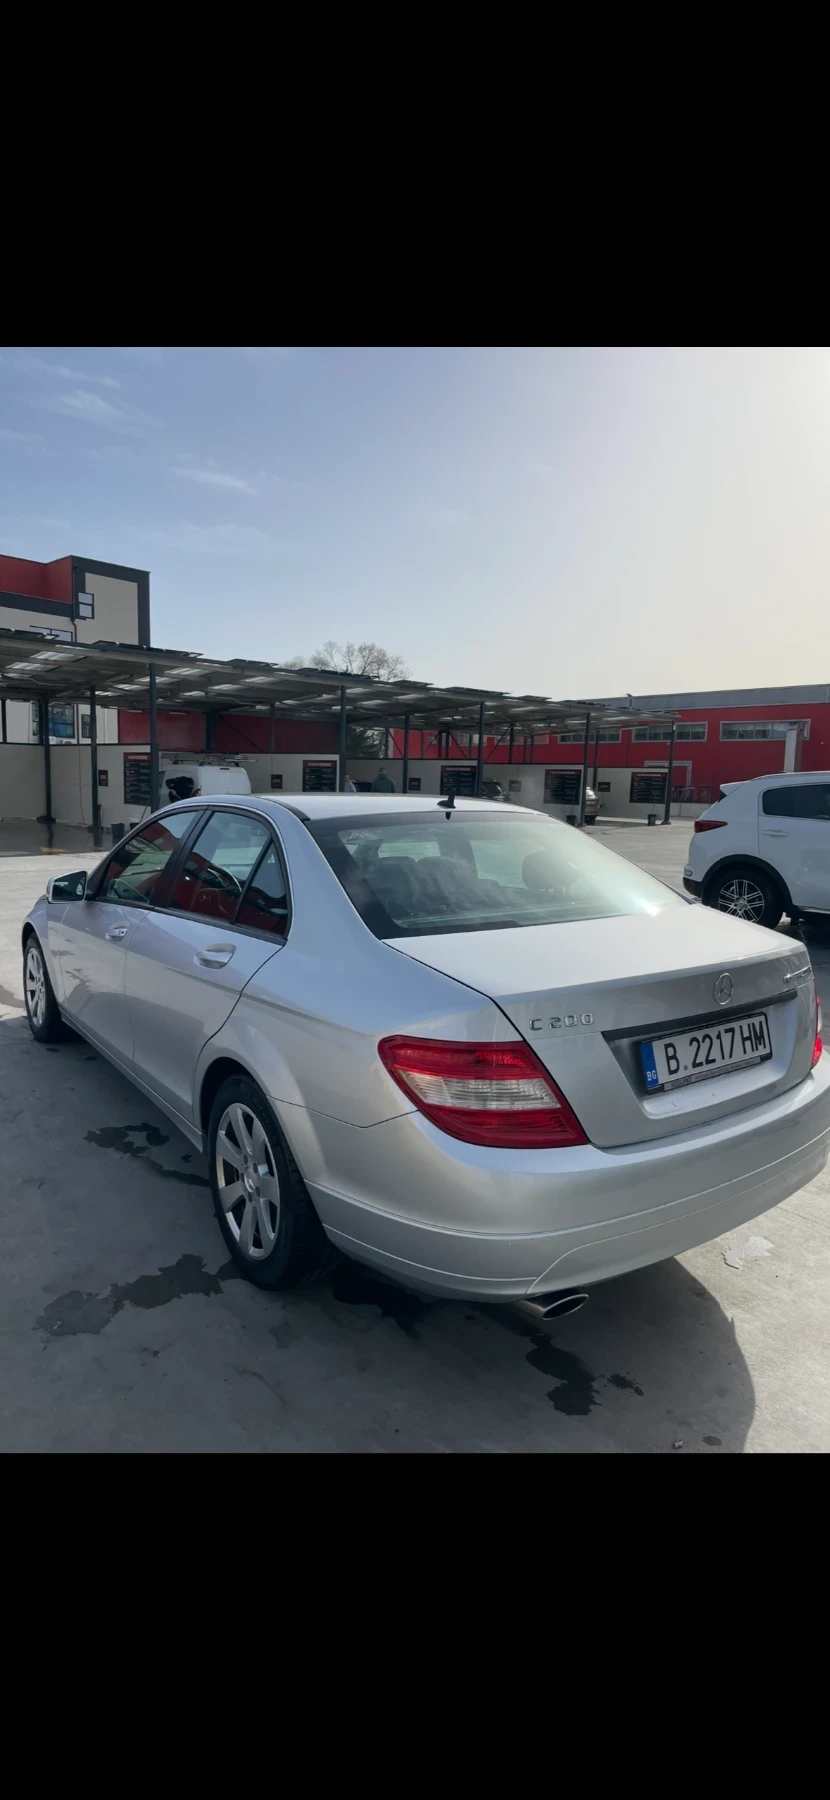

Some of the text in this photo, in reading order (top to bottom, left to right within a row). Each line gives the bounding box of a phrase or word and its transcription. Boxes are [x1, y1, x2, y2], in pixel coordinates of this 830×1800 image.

[529, 1013, 594, 1031] C 200
[689, 1027, 736, 1069] 2217
[739, 1020, 767, 1055] HM
[646, 1069, 657, 1082] BG
